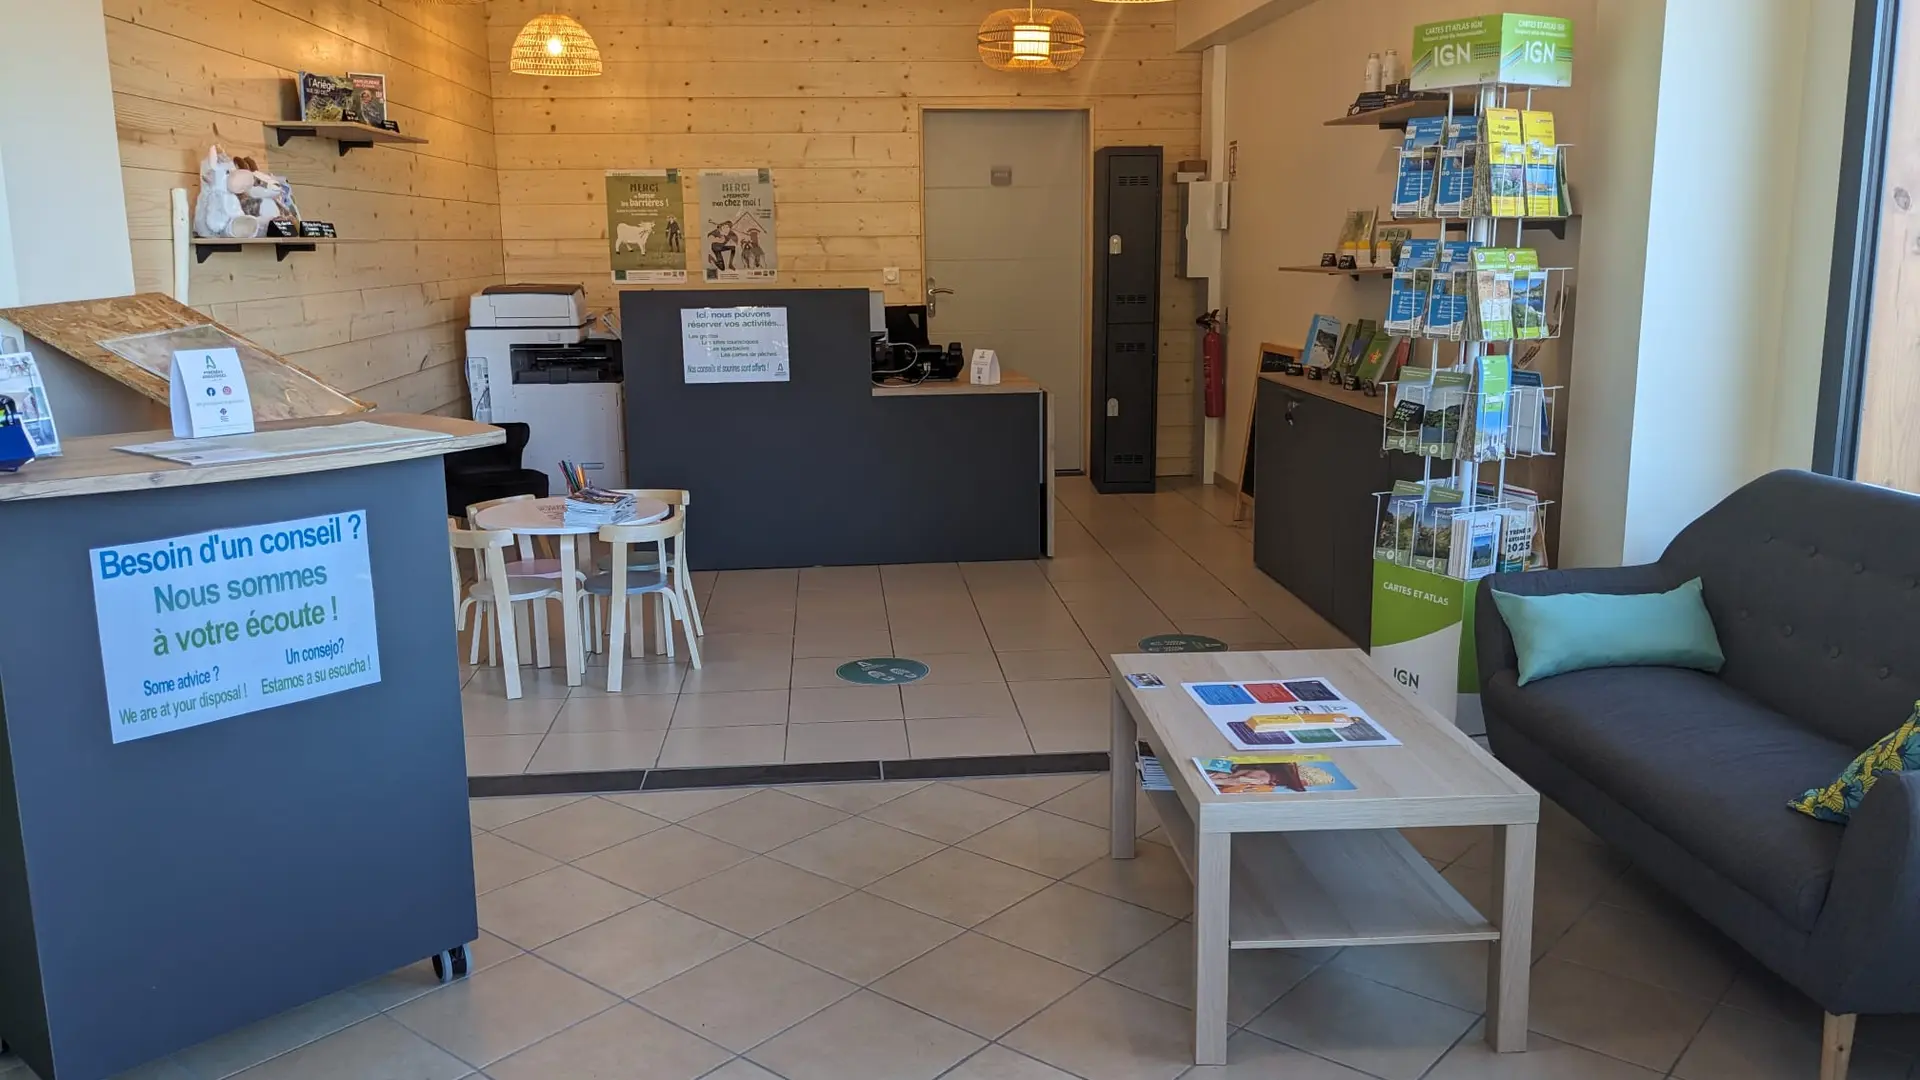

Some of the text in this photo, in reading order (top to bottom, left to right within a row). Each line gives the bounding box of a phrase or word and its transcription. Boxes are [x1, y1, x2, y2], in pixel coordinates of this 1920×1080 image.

[1426, 25, 1443, 35] CARTES
[1444, 24, 1452, 33] ET
[1452, 22, 1469, 31] ATLAS
[1434, 41, 1472, 68] IGN
[1524, 41, 1555, 64] IGN
[629, 198, 664, 207] barrières
[743, 198, 756, 206] moi
[696, 311, 709, 319] Ici,
[734, 311, 771, 321] pouvons
[688, 365, 696, 373] Nos
[100, 514, 361, 580] Besoin d'un conseil ?
[1508, 541, 1530, 553] 2025
[153, 565, 327, 614] Nous sommes
[1383, 582, 1449, 606] CARTES ET ATLAS
[153, 596, 337, 657] à votre écoute !
[286, 638, 344, 665] Un consejo?
[143, 666, 220, 697] Some advice ?
[261, 655, 371, 695] Estamos a su escucha !
[1393, 667, 1420, 689] IGN
[119, 683, 248, 725] We are at your disposal !
